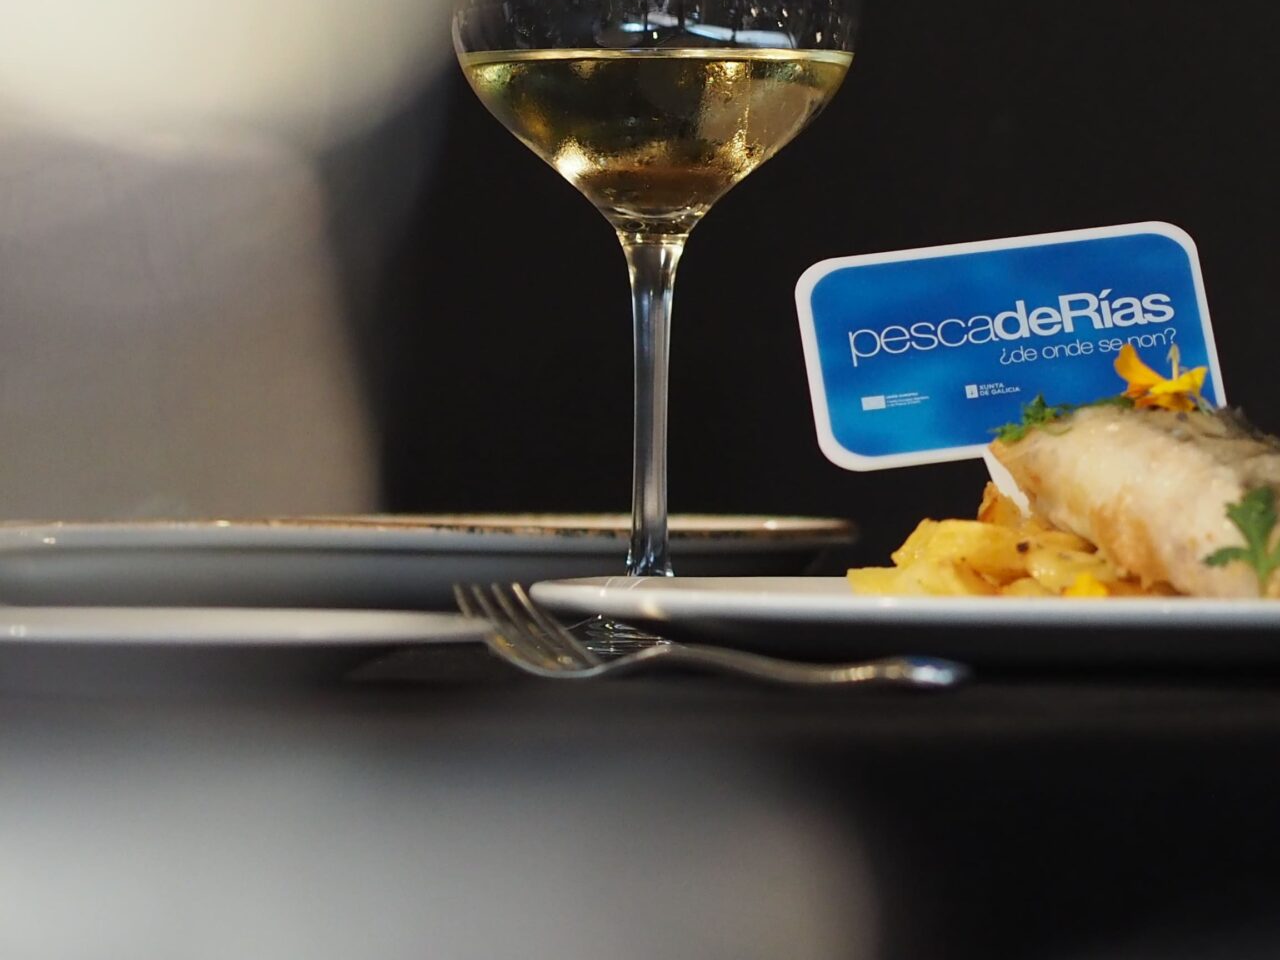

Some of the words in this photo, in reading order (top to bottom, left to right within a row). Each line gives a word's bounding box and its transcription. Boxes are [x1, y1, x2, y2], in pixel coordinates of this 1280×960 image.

[848, 289, 1175, 367] pescadeRías
[999, 341, 1038, 365] ¿de
[1043, 335, 1094, 358] onde
[1098, 338, 1124, 353] se
[990, 386, 1021, 396] GALICIA
